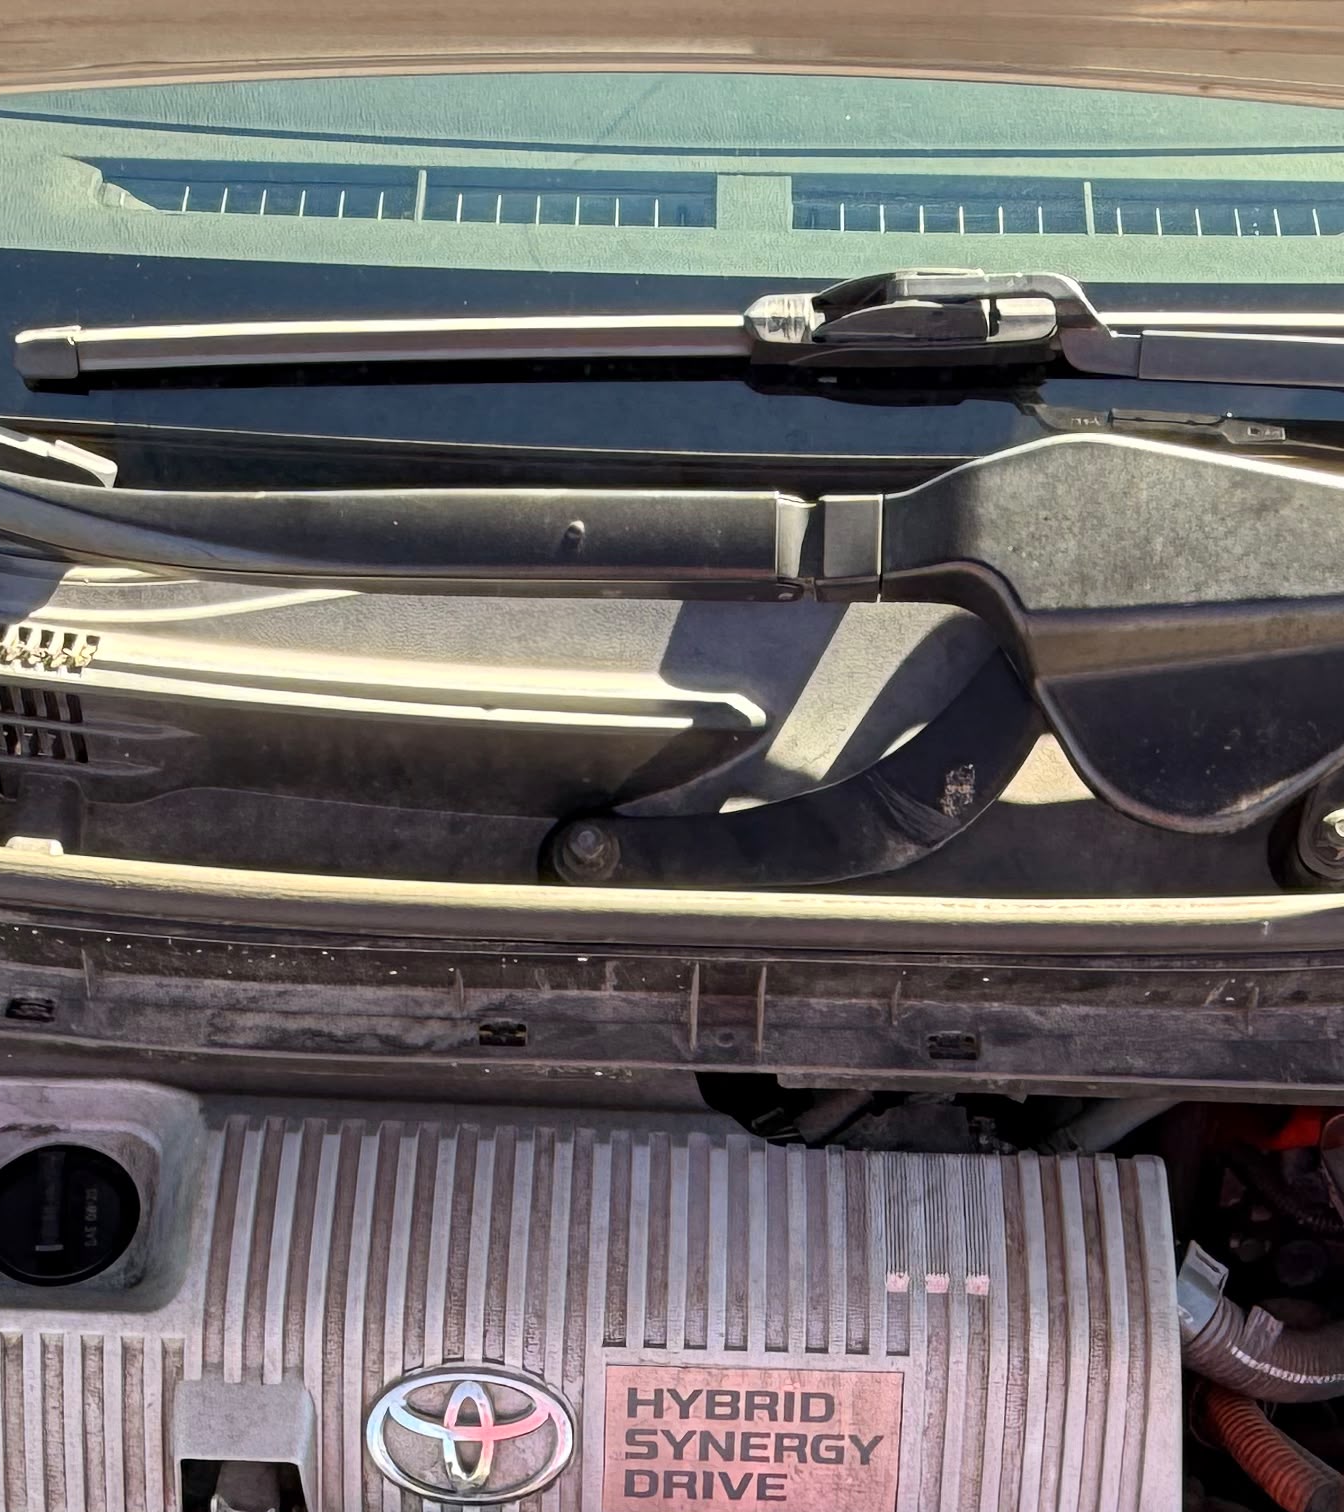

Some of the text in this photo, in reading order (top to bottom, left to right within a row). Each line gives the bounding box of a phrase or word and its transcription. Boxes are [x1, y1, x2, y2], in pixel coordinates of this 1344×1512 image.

[627, 1387, 835, 1423] HYBRID
[625, 1429, 884, 1465] SYNERGY
[624, 1469, 788, 1502] DRIVE
